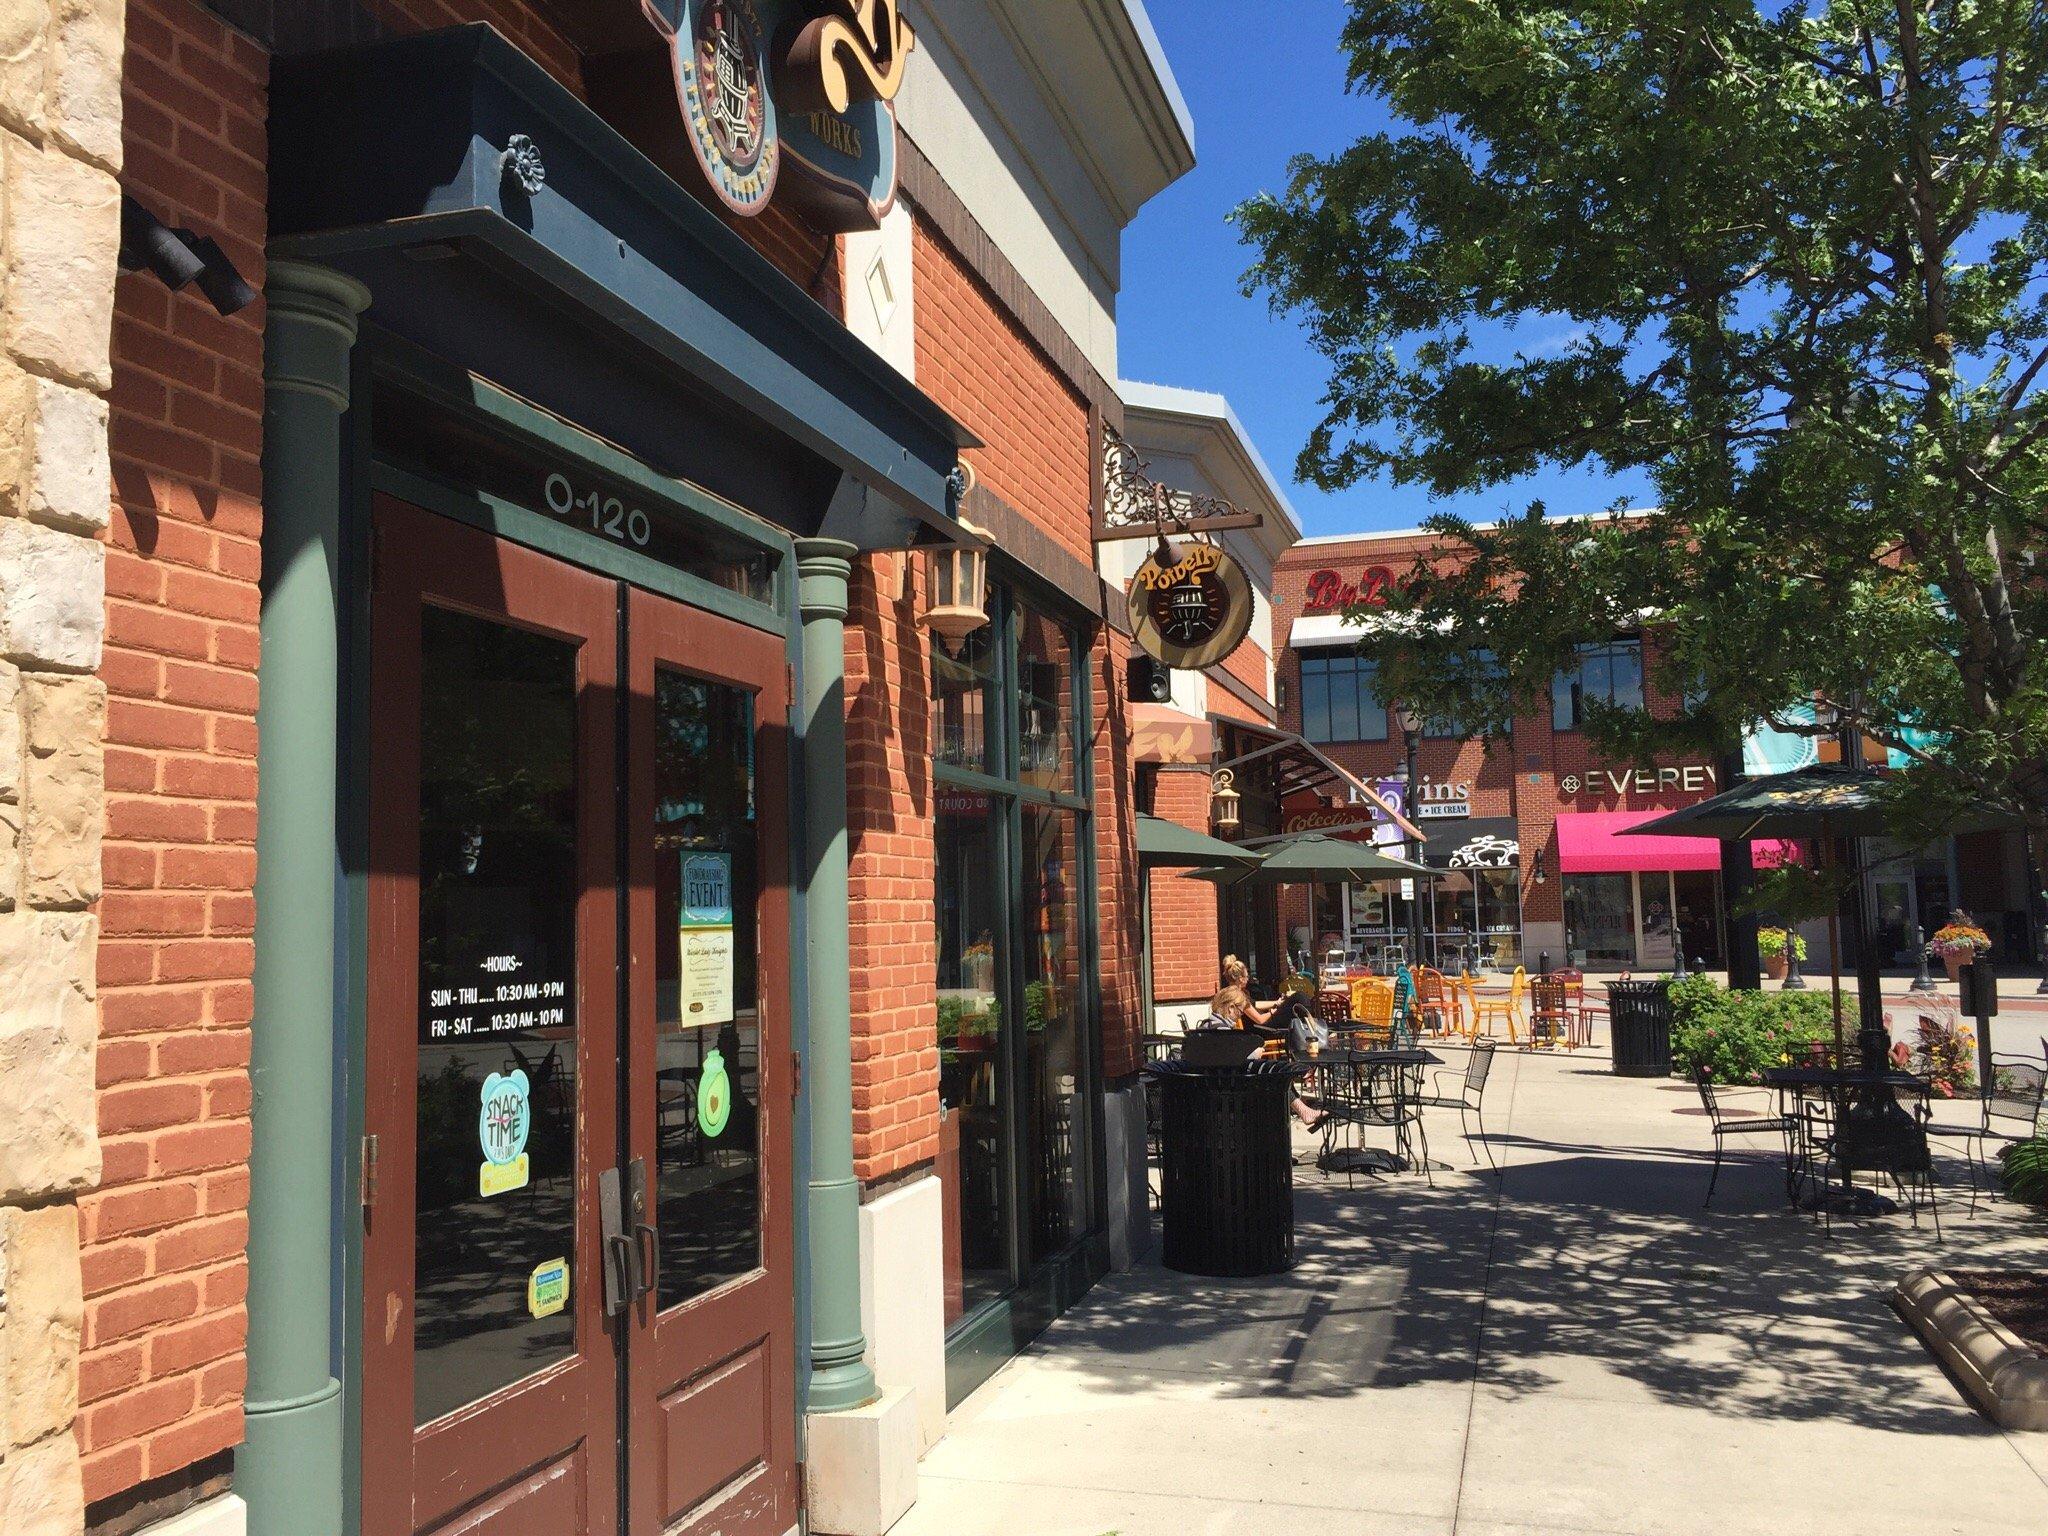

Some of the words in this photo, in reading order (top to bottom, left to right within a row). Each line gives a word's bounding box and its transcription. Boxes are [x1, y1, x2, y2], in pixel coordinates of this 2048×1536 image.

[810, 112, 862, 159] WORKS
[1430, 806, 1442, 815] ICE
[1443, 805, 1468, 815] CREAM
[689, 882, 724, 907] EVENT
[431, 989, 452, 1007] SUN
[459, 987, 478, 1005] THU
[496, 984, 522, 1002] 10:30
[523, 983, 538, 999] AM
[544, 982, 550, 998] 9
[551, 981, 564, 997] PM
[431, 1020, 447, 1037] FRI
[454, 1017, 473, 1035] SAT
[491, 1014, 518, 1031] 10:30
[519, 1013, 533, 1028] AM
[539, 1009, 549, 1026] 10
[550, 1008, 564, 1024] PM
[486, 1094, 524, 1120] SNACK
[487, 1117, 521, 1148] TIME
